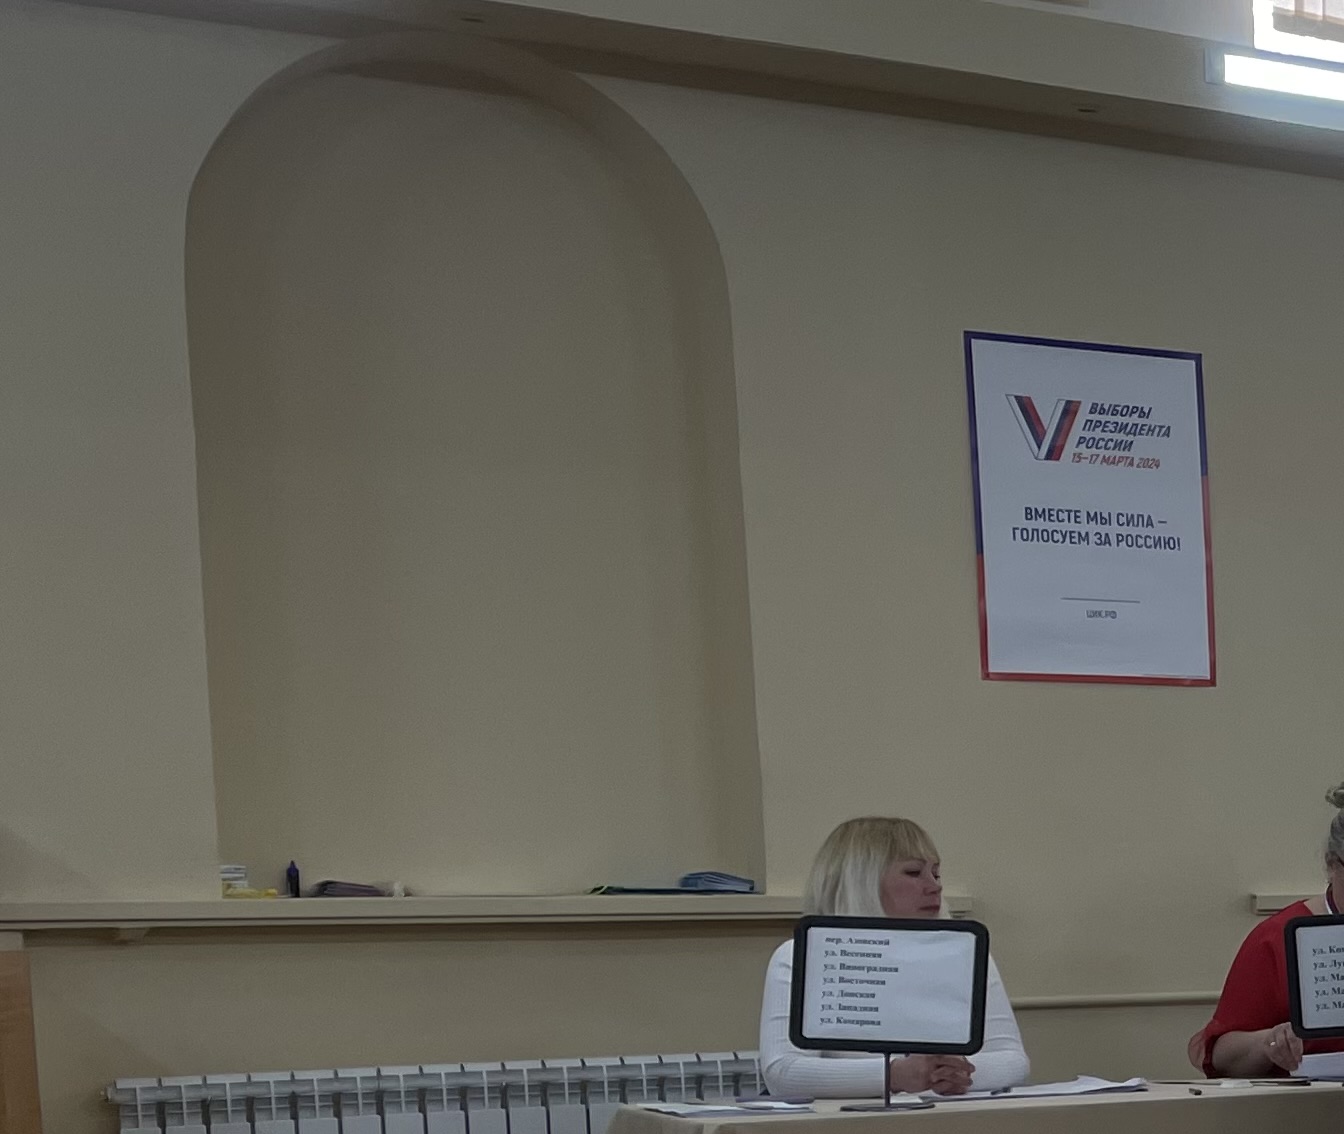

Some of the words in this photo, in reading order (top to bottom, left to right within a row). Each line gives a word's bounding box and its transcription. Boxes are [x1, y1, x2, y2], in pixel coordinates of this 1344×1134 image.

[1088, 402, 1153, 419] ВЫБОРЫ
[1082, 419, 1171, 438] ПРЕЗИДЕНТА
[1075, 436, 1133, 452] РОССИИ
[1100, 455, 1135, 468] МАРТА
[1136, 457, 1161, 470] 2024
[1024, 507, 1082, 525] ВМЕСТЕ
[1086, 511, 1112, 527] МЫ
[1116, 513, 1155, 529] СИЛА
[1012, 527, 1090, 547] ГОЛОСУЕМ
[1094, 532, 1113, 547] ЗА
[1116, 534, 1181, 551] РОССИЮ!
